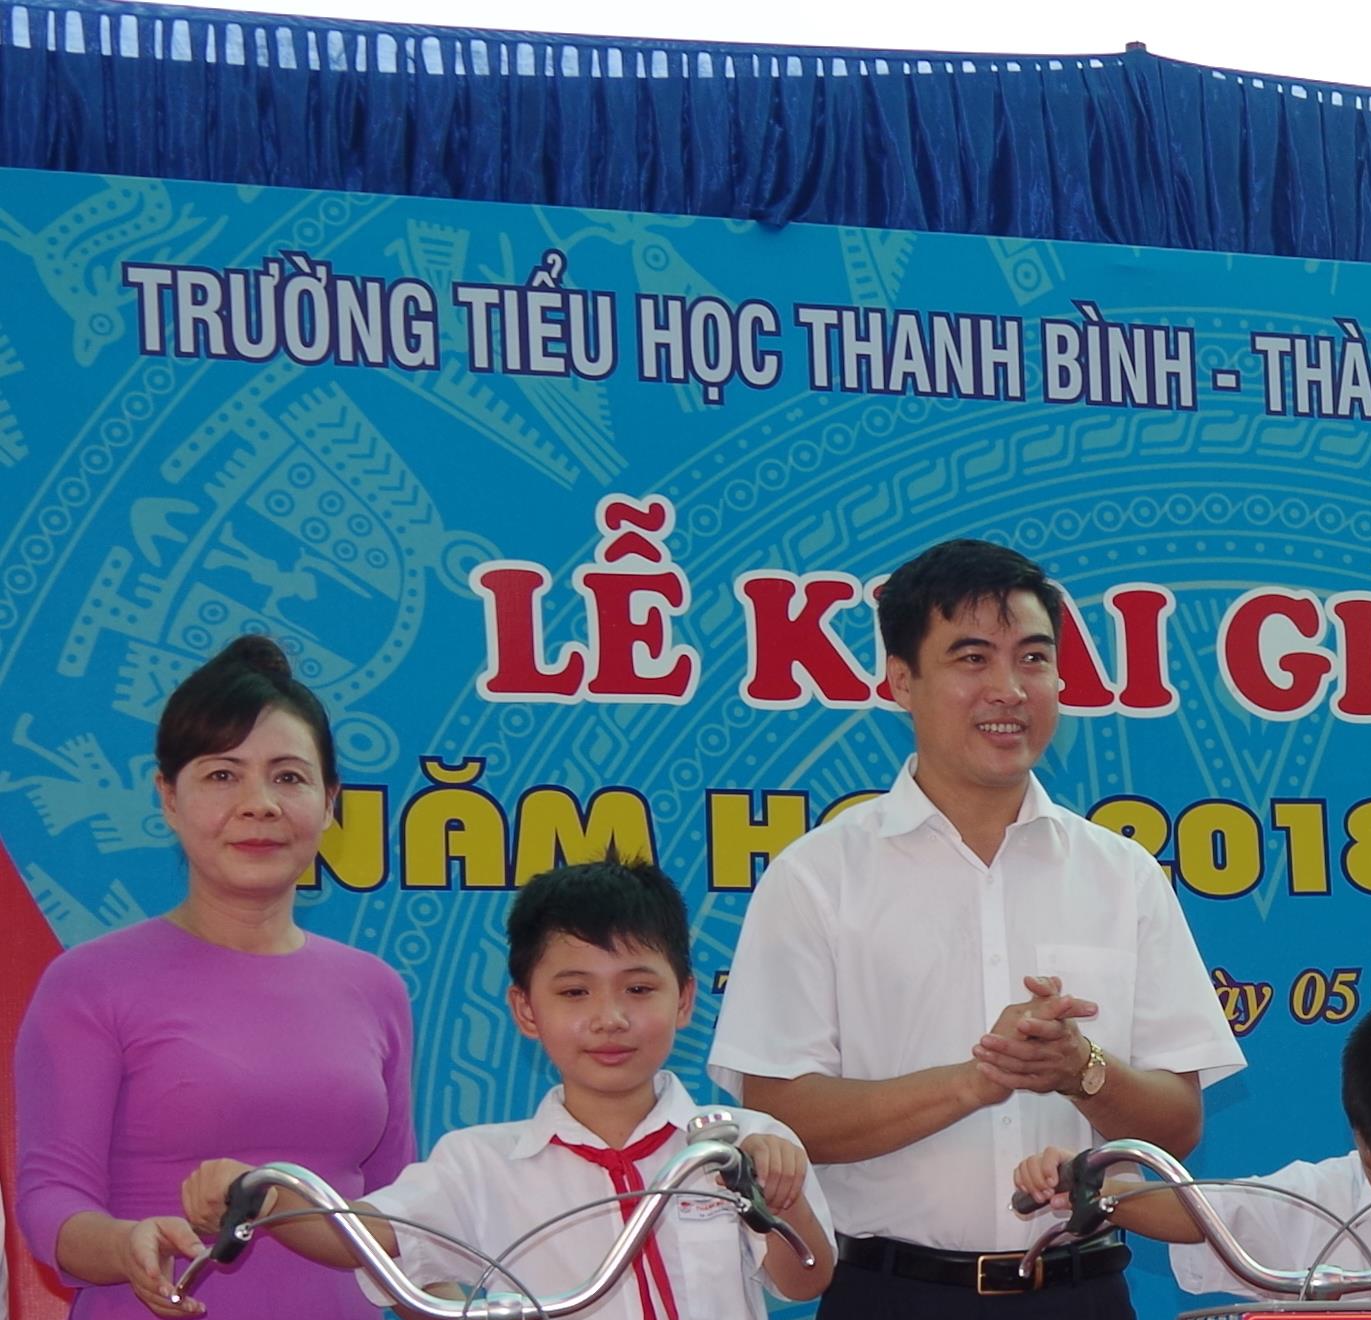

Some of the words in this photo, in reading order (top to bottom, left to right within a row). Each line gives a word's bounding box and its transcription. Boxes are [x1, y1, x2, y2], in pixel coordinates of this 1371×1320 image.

[125, 255, 437, 369] TRƯỜNG
[456, 252, 615, 377] TIỂU
[640, 297, 781, 401] HỌC
[799, 307, 1021, 398] THANH
[1046, 304, 1195, 407] BÌNH
[476, 499, 696, 698] LỄ
[742, 576, 1174, 709] KAI
[297, 755, 658, 890] NĂM
[1213, 968, 1274, 1035] ày
[1291, 970, 1358, 1022] 05
